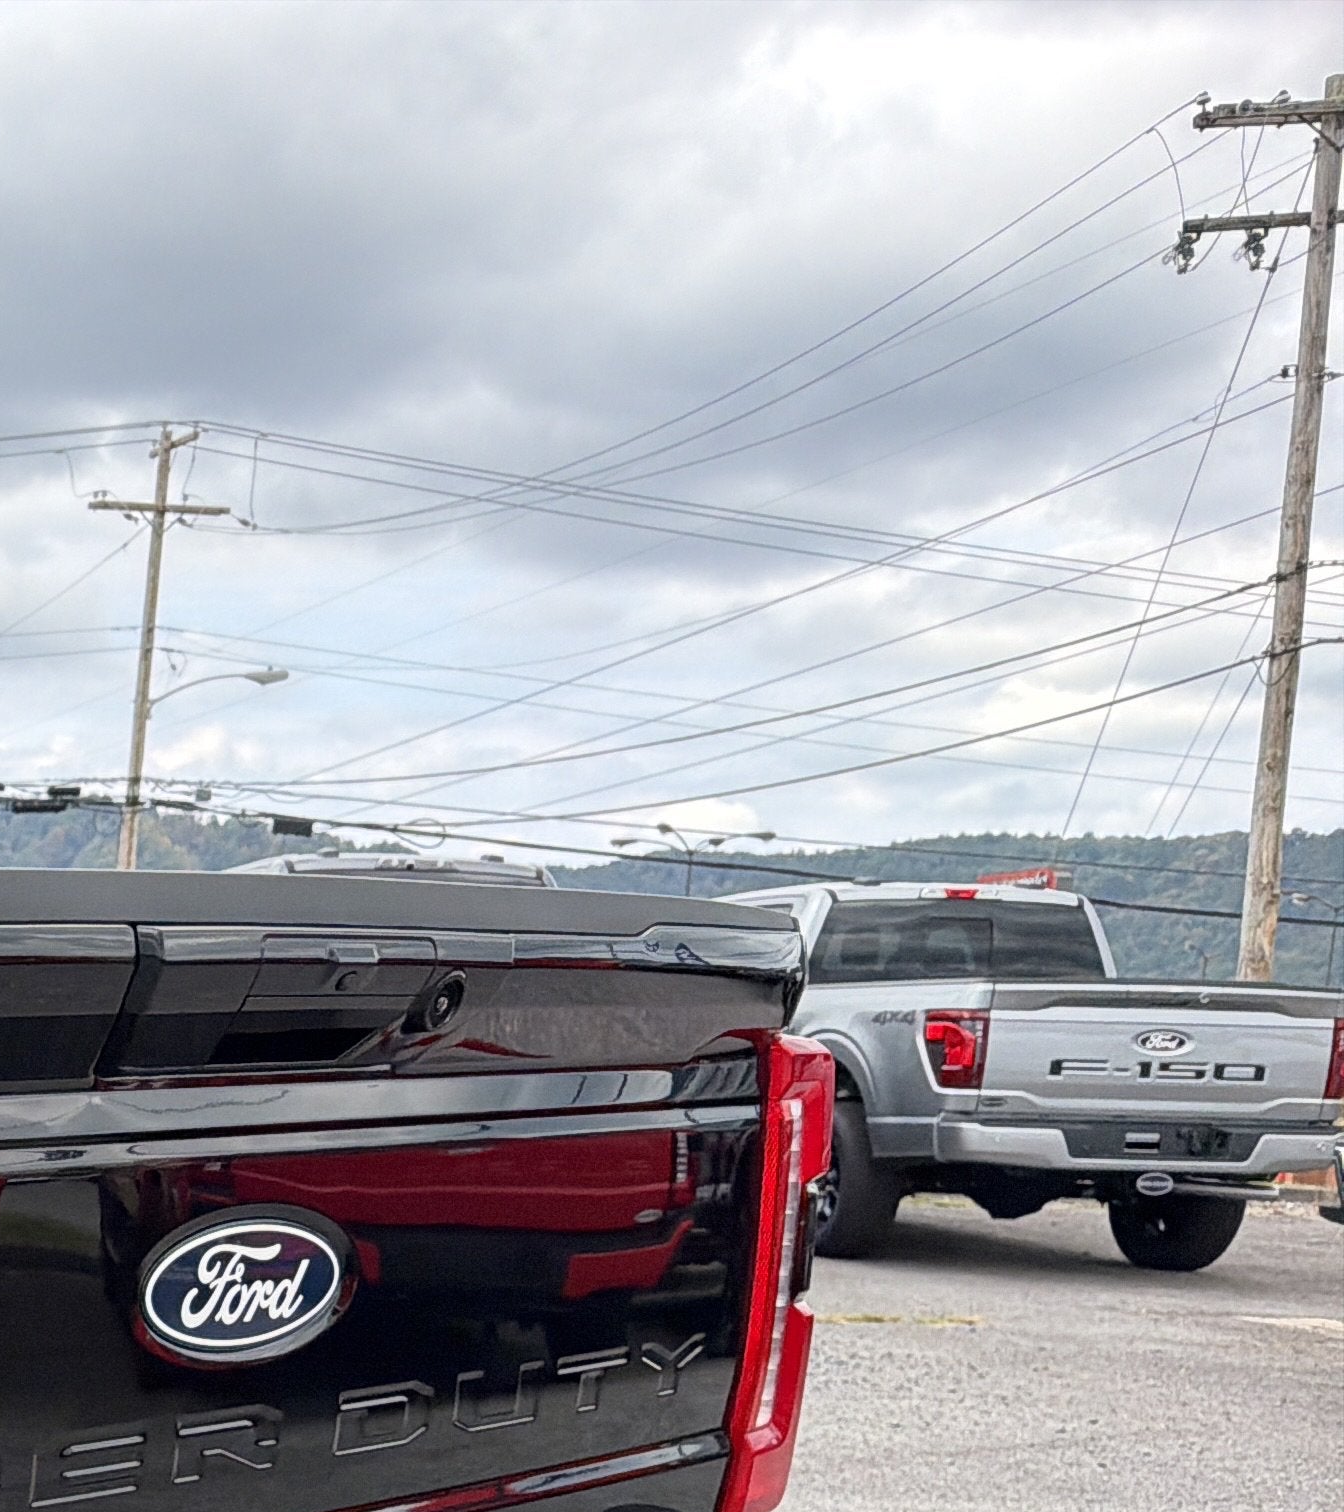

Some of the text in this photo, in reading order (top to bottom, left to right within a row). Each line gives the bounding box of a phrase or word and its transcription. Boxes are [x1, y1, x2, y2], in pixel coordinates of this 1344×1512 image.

[1145, 1030, 1180, 1049] Ford
[1046, 1058, 1268, 1084] F-150
[180, 1243, 311, 1329] Ford
[331, 1331, 707, 1456] DUTY
